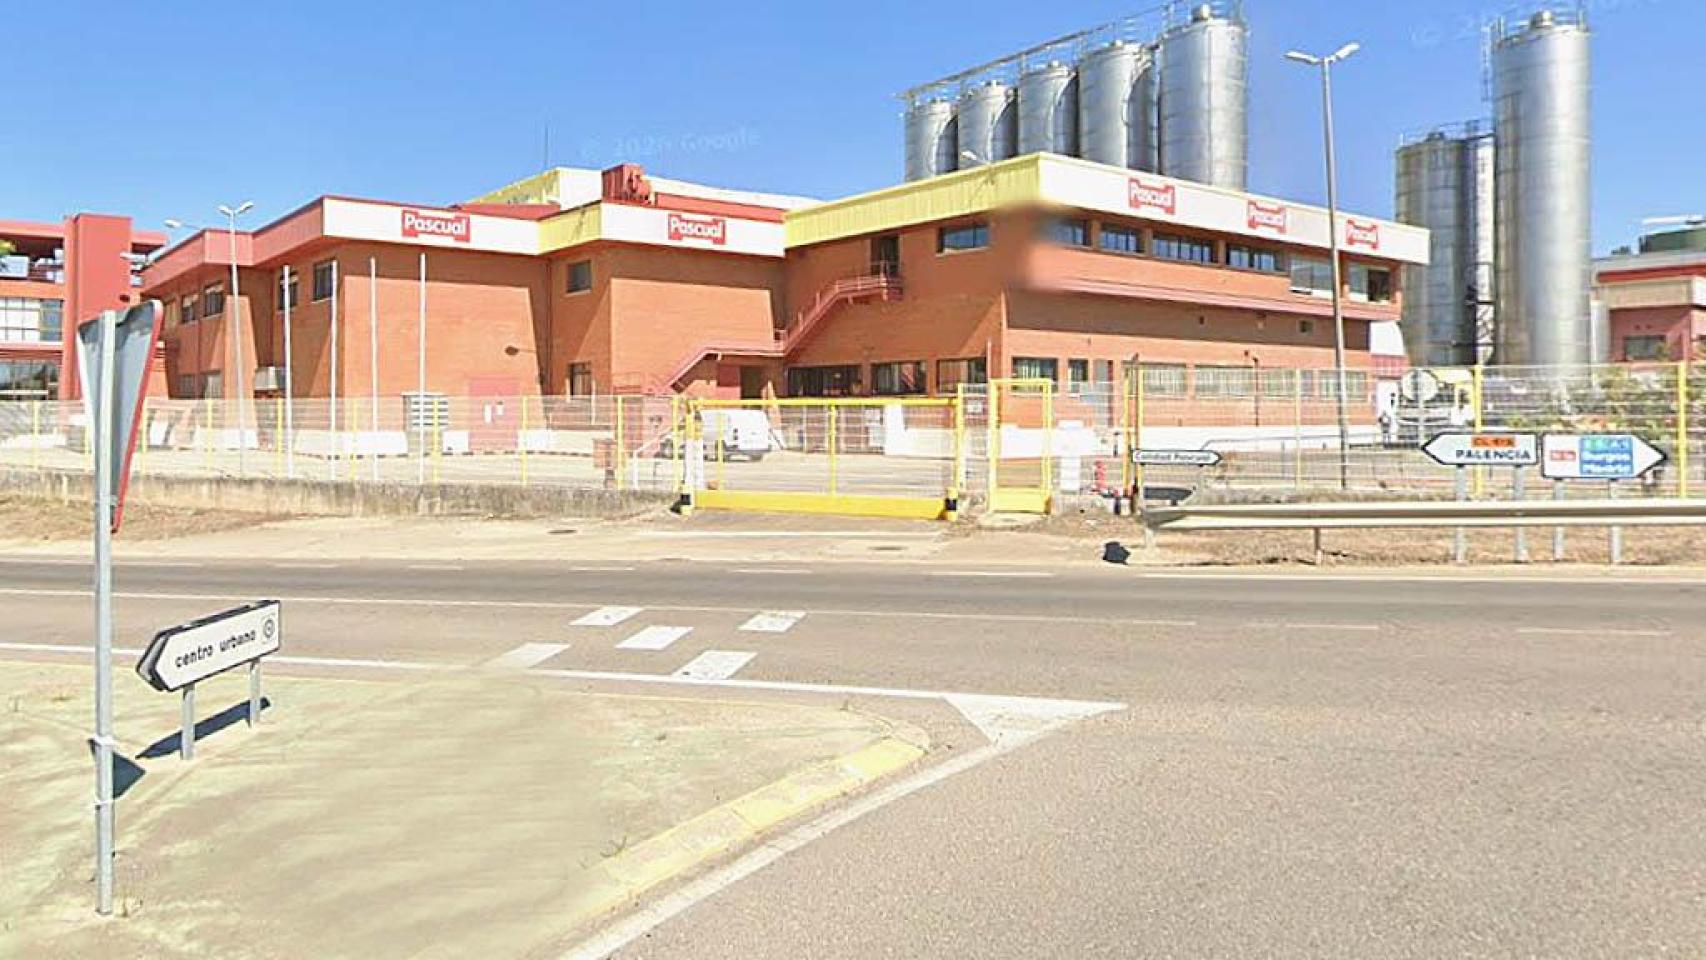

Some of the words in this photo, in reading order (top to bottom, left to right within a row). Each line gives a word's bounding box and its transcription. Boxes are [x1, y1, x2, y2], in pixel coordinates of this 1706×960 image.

[1129, 183, 1173, 209] Pascual
[404, 212, 466, 236] Pascual
[671, 216, 723, 239] Pascual
[1455, 449, 1531, 460] PALENCIA
[175, 644, 213, 668] centro
[220, 630, 256, 652] urbano
